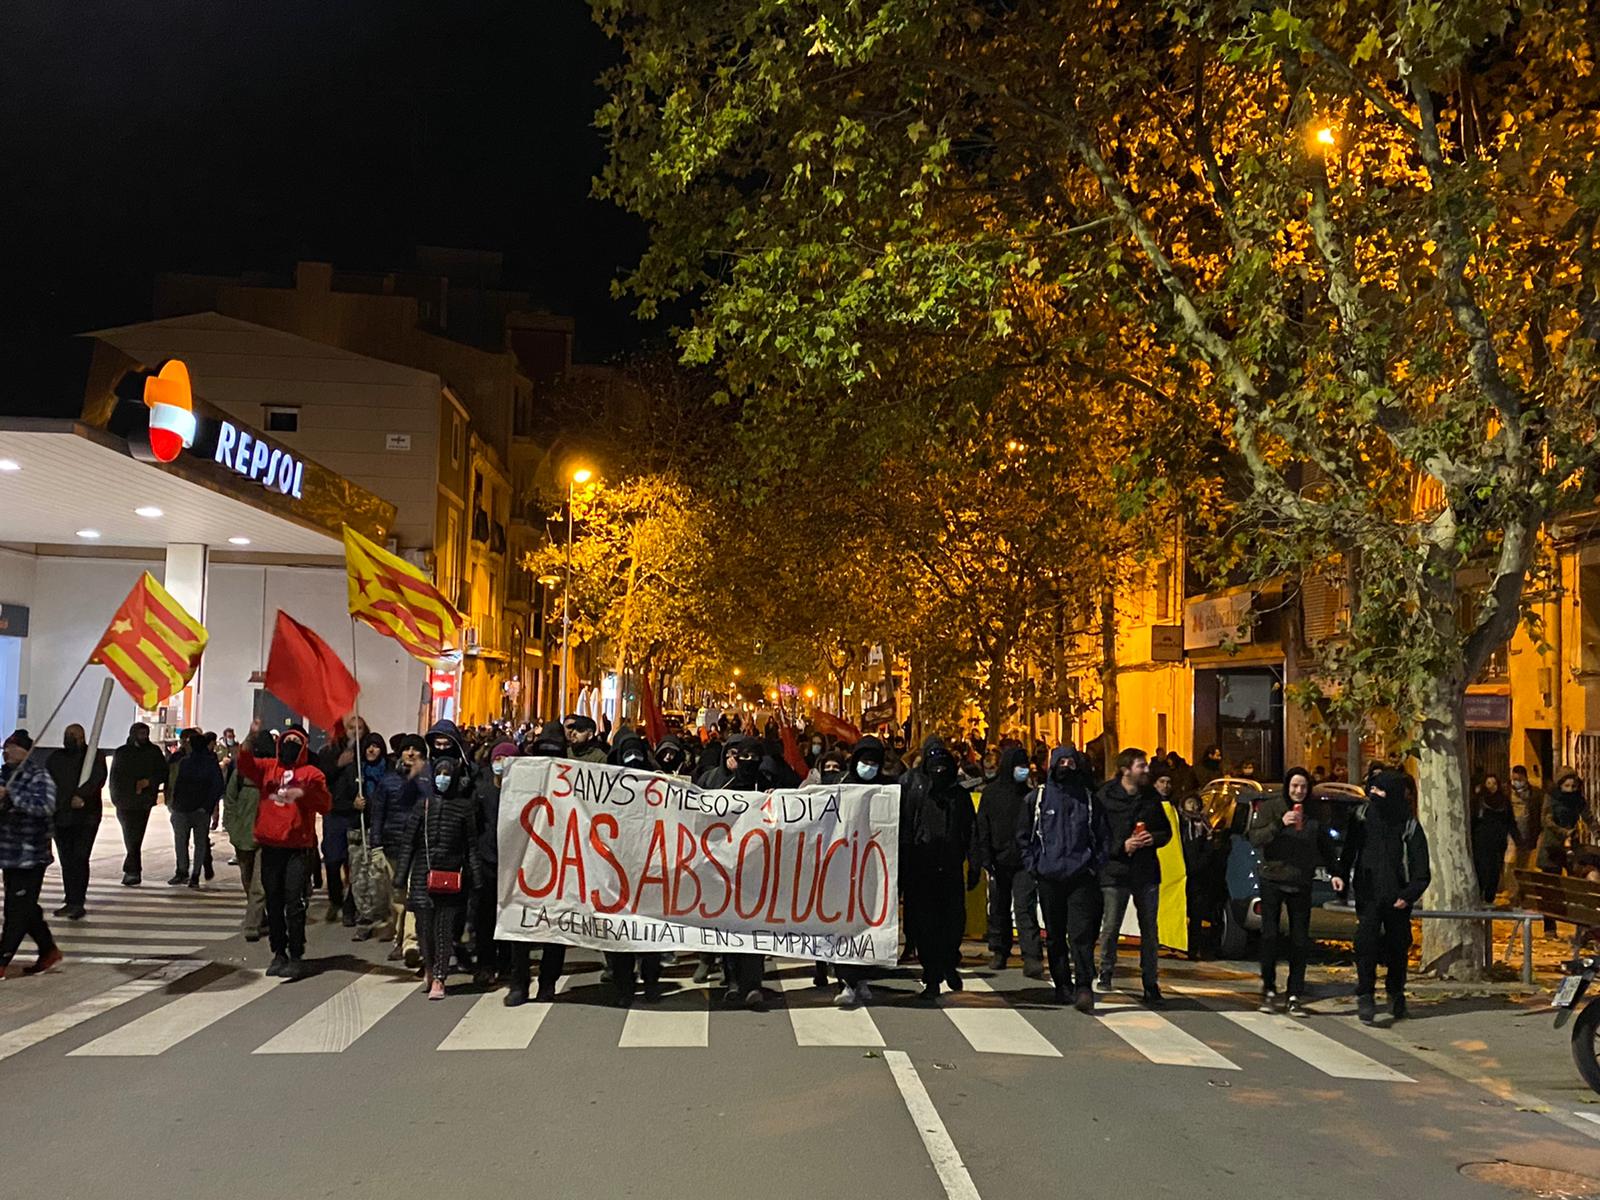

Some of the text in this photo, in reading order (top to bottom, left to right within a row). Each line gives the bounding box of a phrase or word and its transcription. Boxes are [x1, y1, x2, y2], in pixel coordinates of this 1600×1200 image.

[214, 420, 303, 500] REPSOL
[552, 763, 574, 798] 3
[573, 768, 639, 806] ANYS
[644, 777, 668, 807] 6
[664, 781, 749, 818] MESOS
[760, 794, 778, 824] 1
[518, 796, 630, 914] SAS
[521, 905, 876, 960] LA GENERALITAT ENS EMPRESONA
